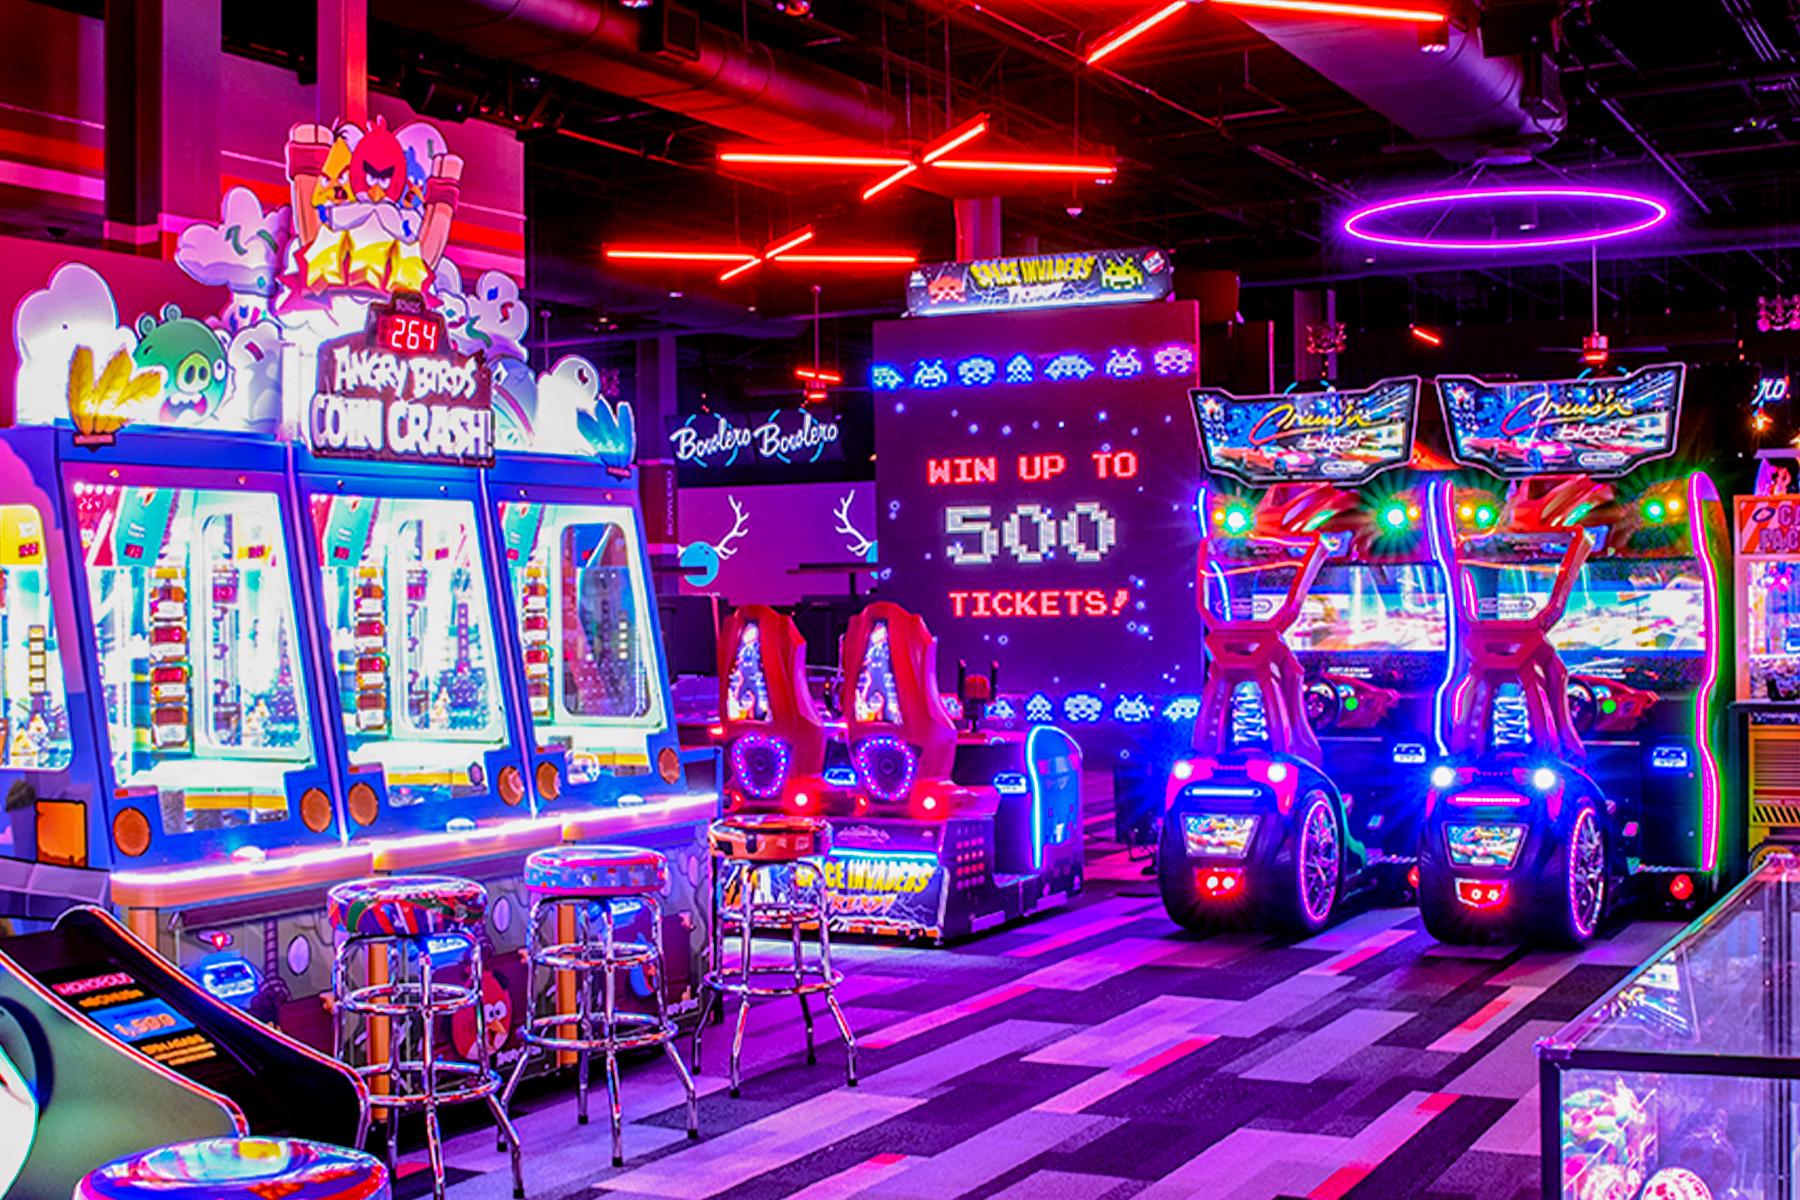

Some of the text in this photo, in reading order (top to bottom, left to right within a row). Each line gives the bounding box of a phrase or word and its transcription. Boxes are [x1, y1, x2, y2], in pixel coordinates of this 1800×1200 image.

[970, 253, 1097, 287] SPACE INVADERS
[391, 318, 437, 350] 264
[334, 345, 477, 400] ANGRY BIRDS
[312, 393, 495, 458] COIN CRASH!
[669, 417, 751, 460] Bowlero
[753, 412, 838, 457] Bowlero
[927, 451, 1138, 485] WIN UP TO
[946, 502, 1116, 563] 500
[948, 588, 1130, 617] TICKETS!
[796, 860, 937, 893] SPCE INVADERS
[55, 972, 133, 995] MONOPOLY
